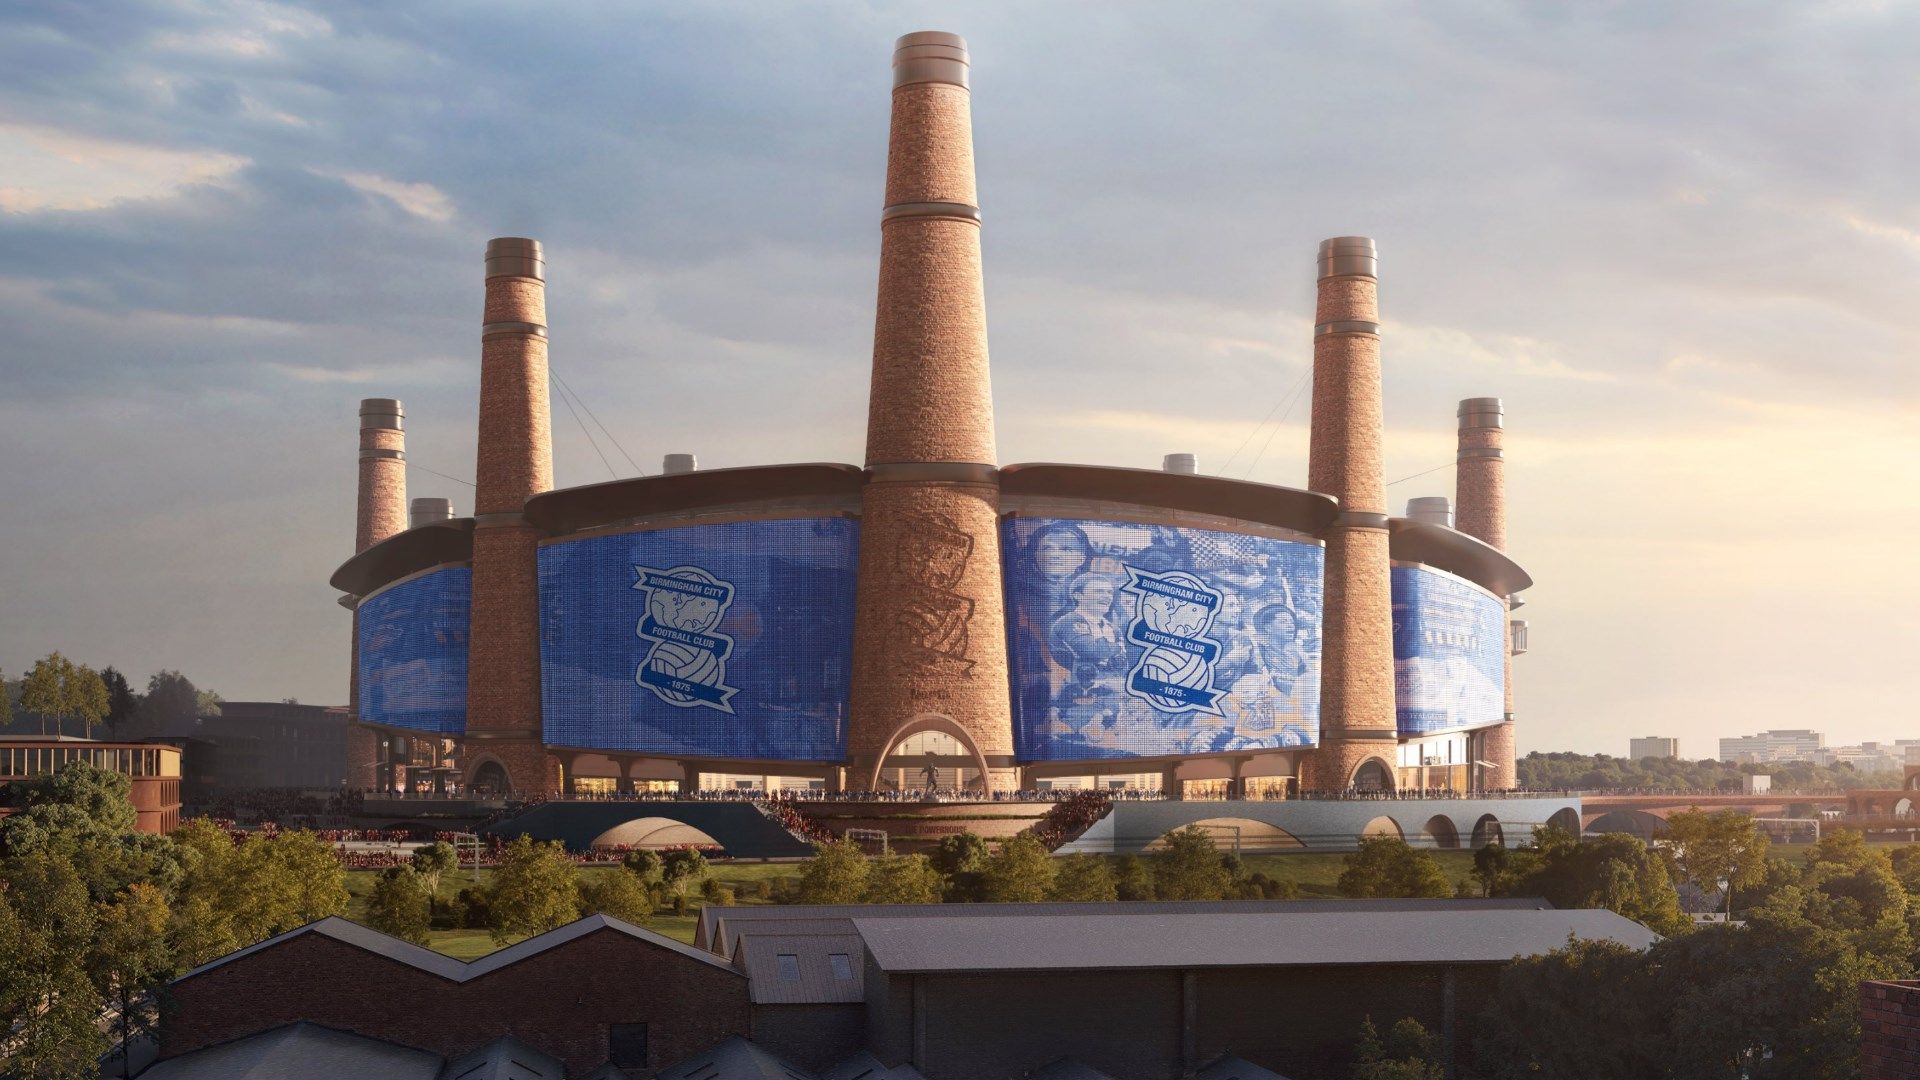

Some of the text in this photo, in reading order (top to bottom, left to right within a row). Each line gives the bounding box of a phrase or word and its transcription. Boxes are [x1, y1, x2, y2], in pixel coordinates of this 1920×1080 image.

[650, 576, 724, 597] BIRMINGHAM CITY
[1142, 579, 1213, 604] BIRMINGHAM CITY
[652, 628, 715, 648] FOOTBALL CLUB
[1144, 632, 1205, 653] FOOTBALL CLUB
